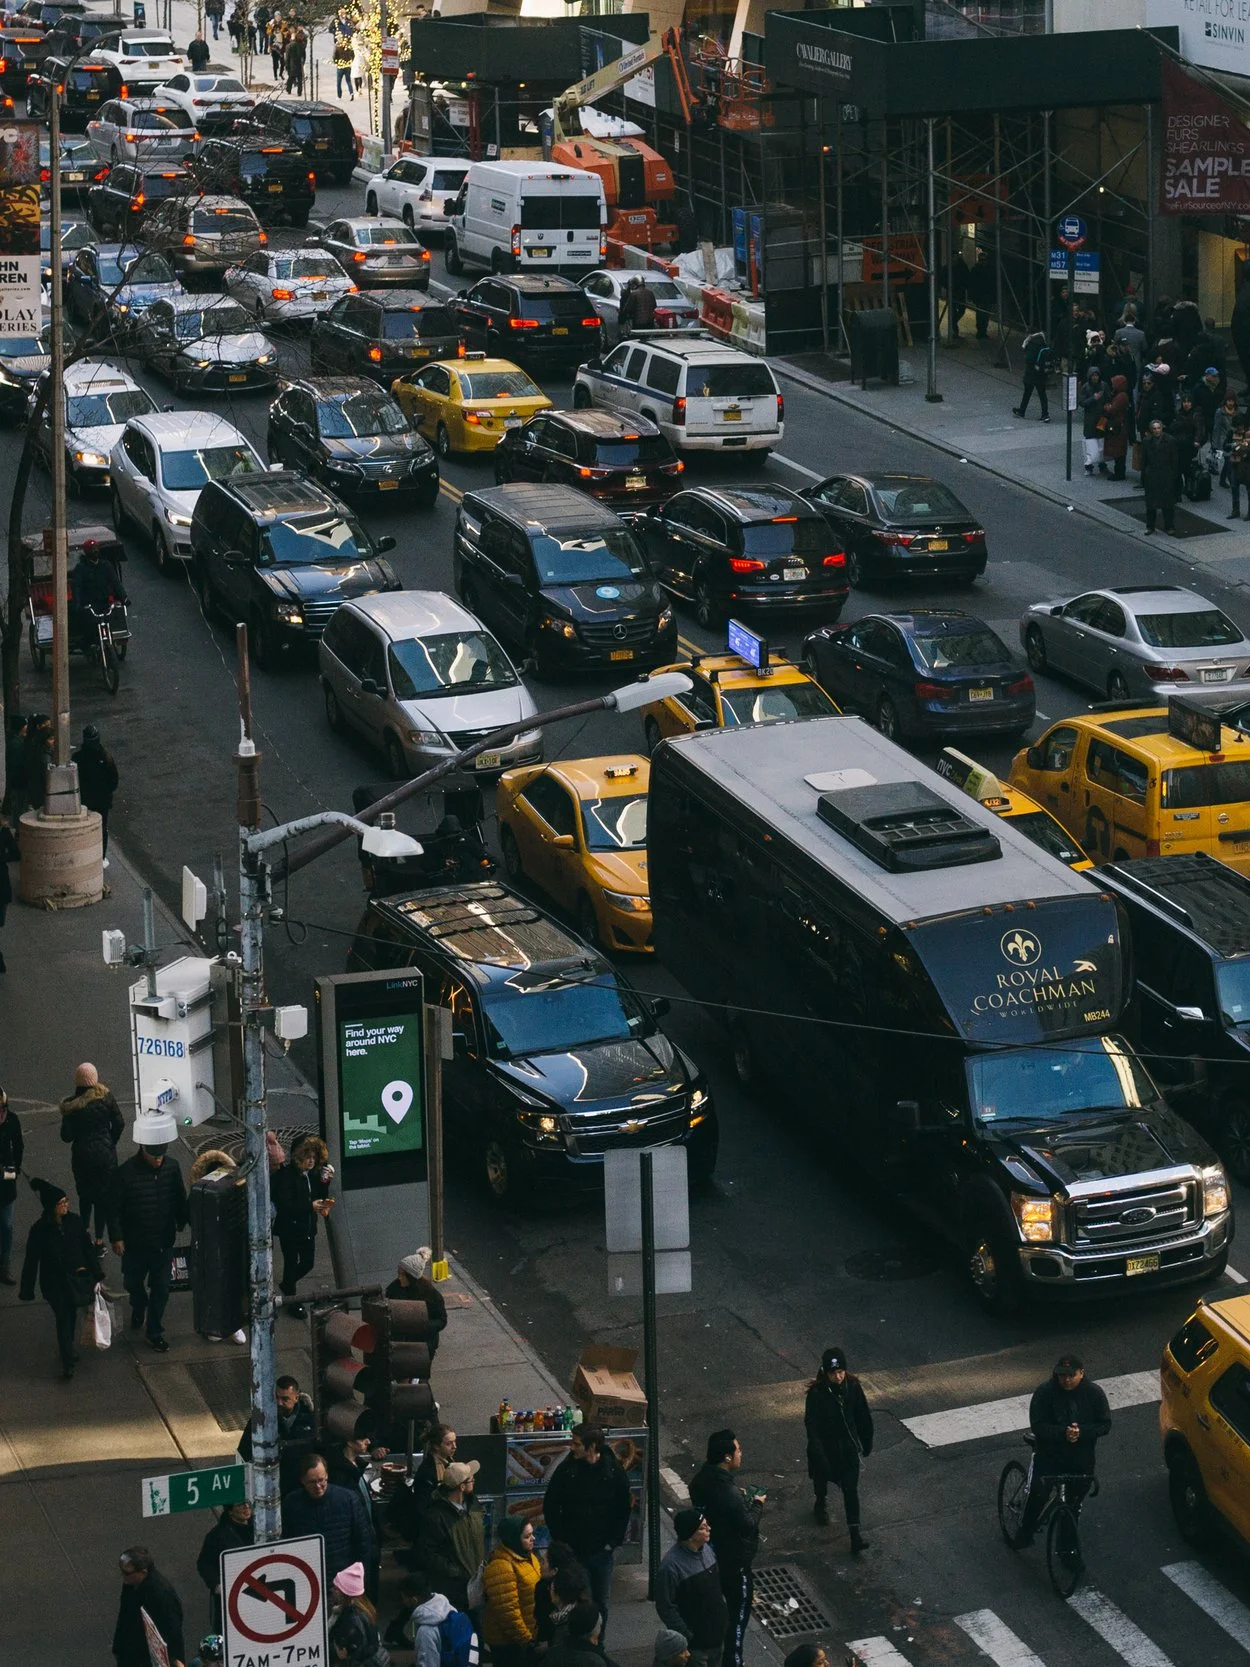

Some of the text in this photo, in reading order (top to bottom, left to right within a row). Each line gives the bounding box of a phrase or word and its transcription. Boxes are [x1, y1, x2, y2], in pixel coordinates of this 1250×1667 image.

[1213, 23, 1244, 43] SINVIN
[1167, 115, 1230, 128] DESIGNER
[1167, 128, 1199, 141] FURS
[1165, 141, 1245, 154] SHEARLINGS
[1165, 178, 1220, 199] SALE
[996, 966, 1064, 989] ROYAL
[973, 979, 1096, 1011] COACHMAN
[345, 1025, 405, 1038] Find your way
[138, 1037, 184, 1058] 726168
[345, 1034, 397, 1047] around NYC
[346, 1048, 368, 1057] here.
[187, 1477, 200, 1505] 5
